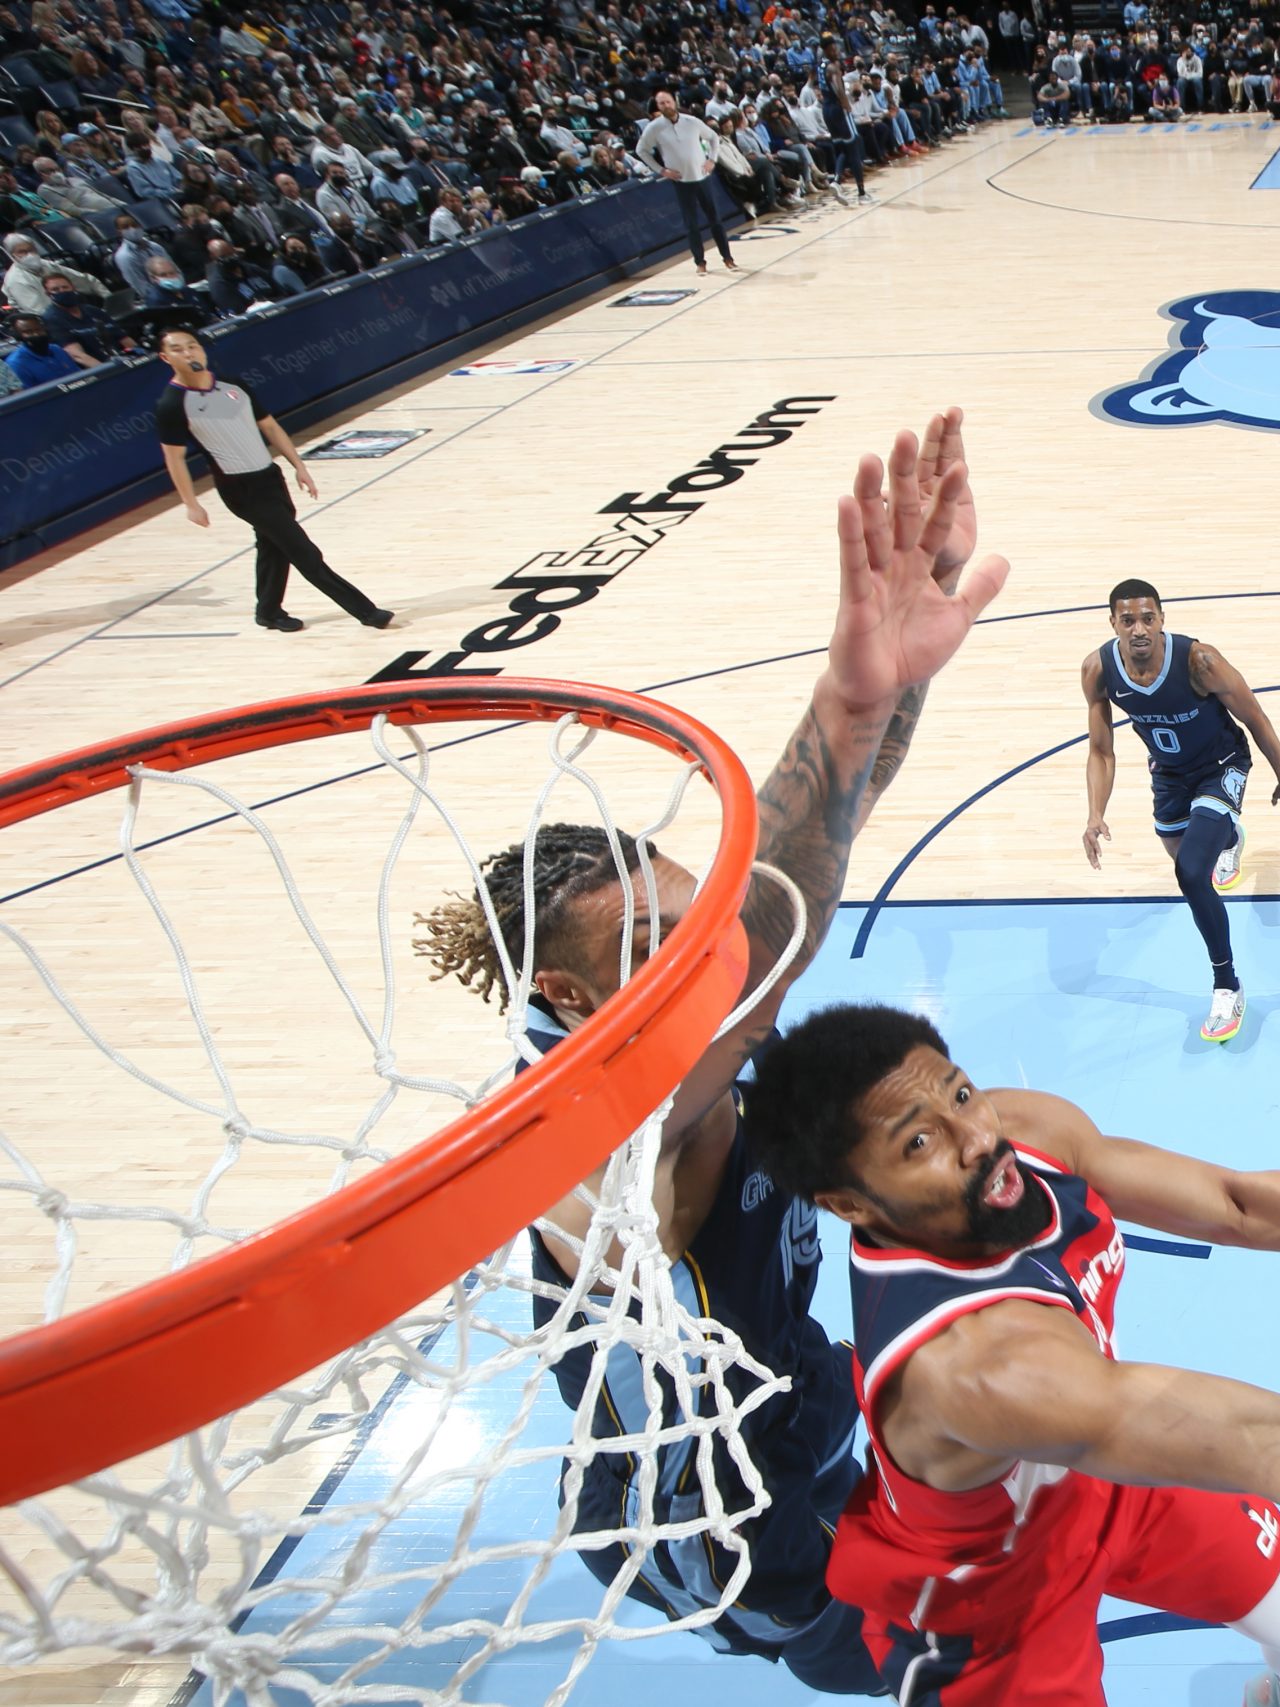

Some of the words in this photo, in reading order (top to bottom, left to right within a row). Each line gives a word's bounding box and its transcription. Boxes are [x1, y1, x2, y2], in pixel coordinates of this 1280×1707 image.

[261, 337, 341, 375] Together
[336, 327, 363, 346] for
[362, 318, 391, 338] the
[364, 395, 838, 685] FedExForum
[1129, 708, 1199, 725] RIZZLIES
[1152, 728, 1181, 754] 0
